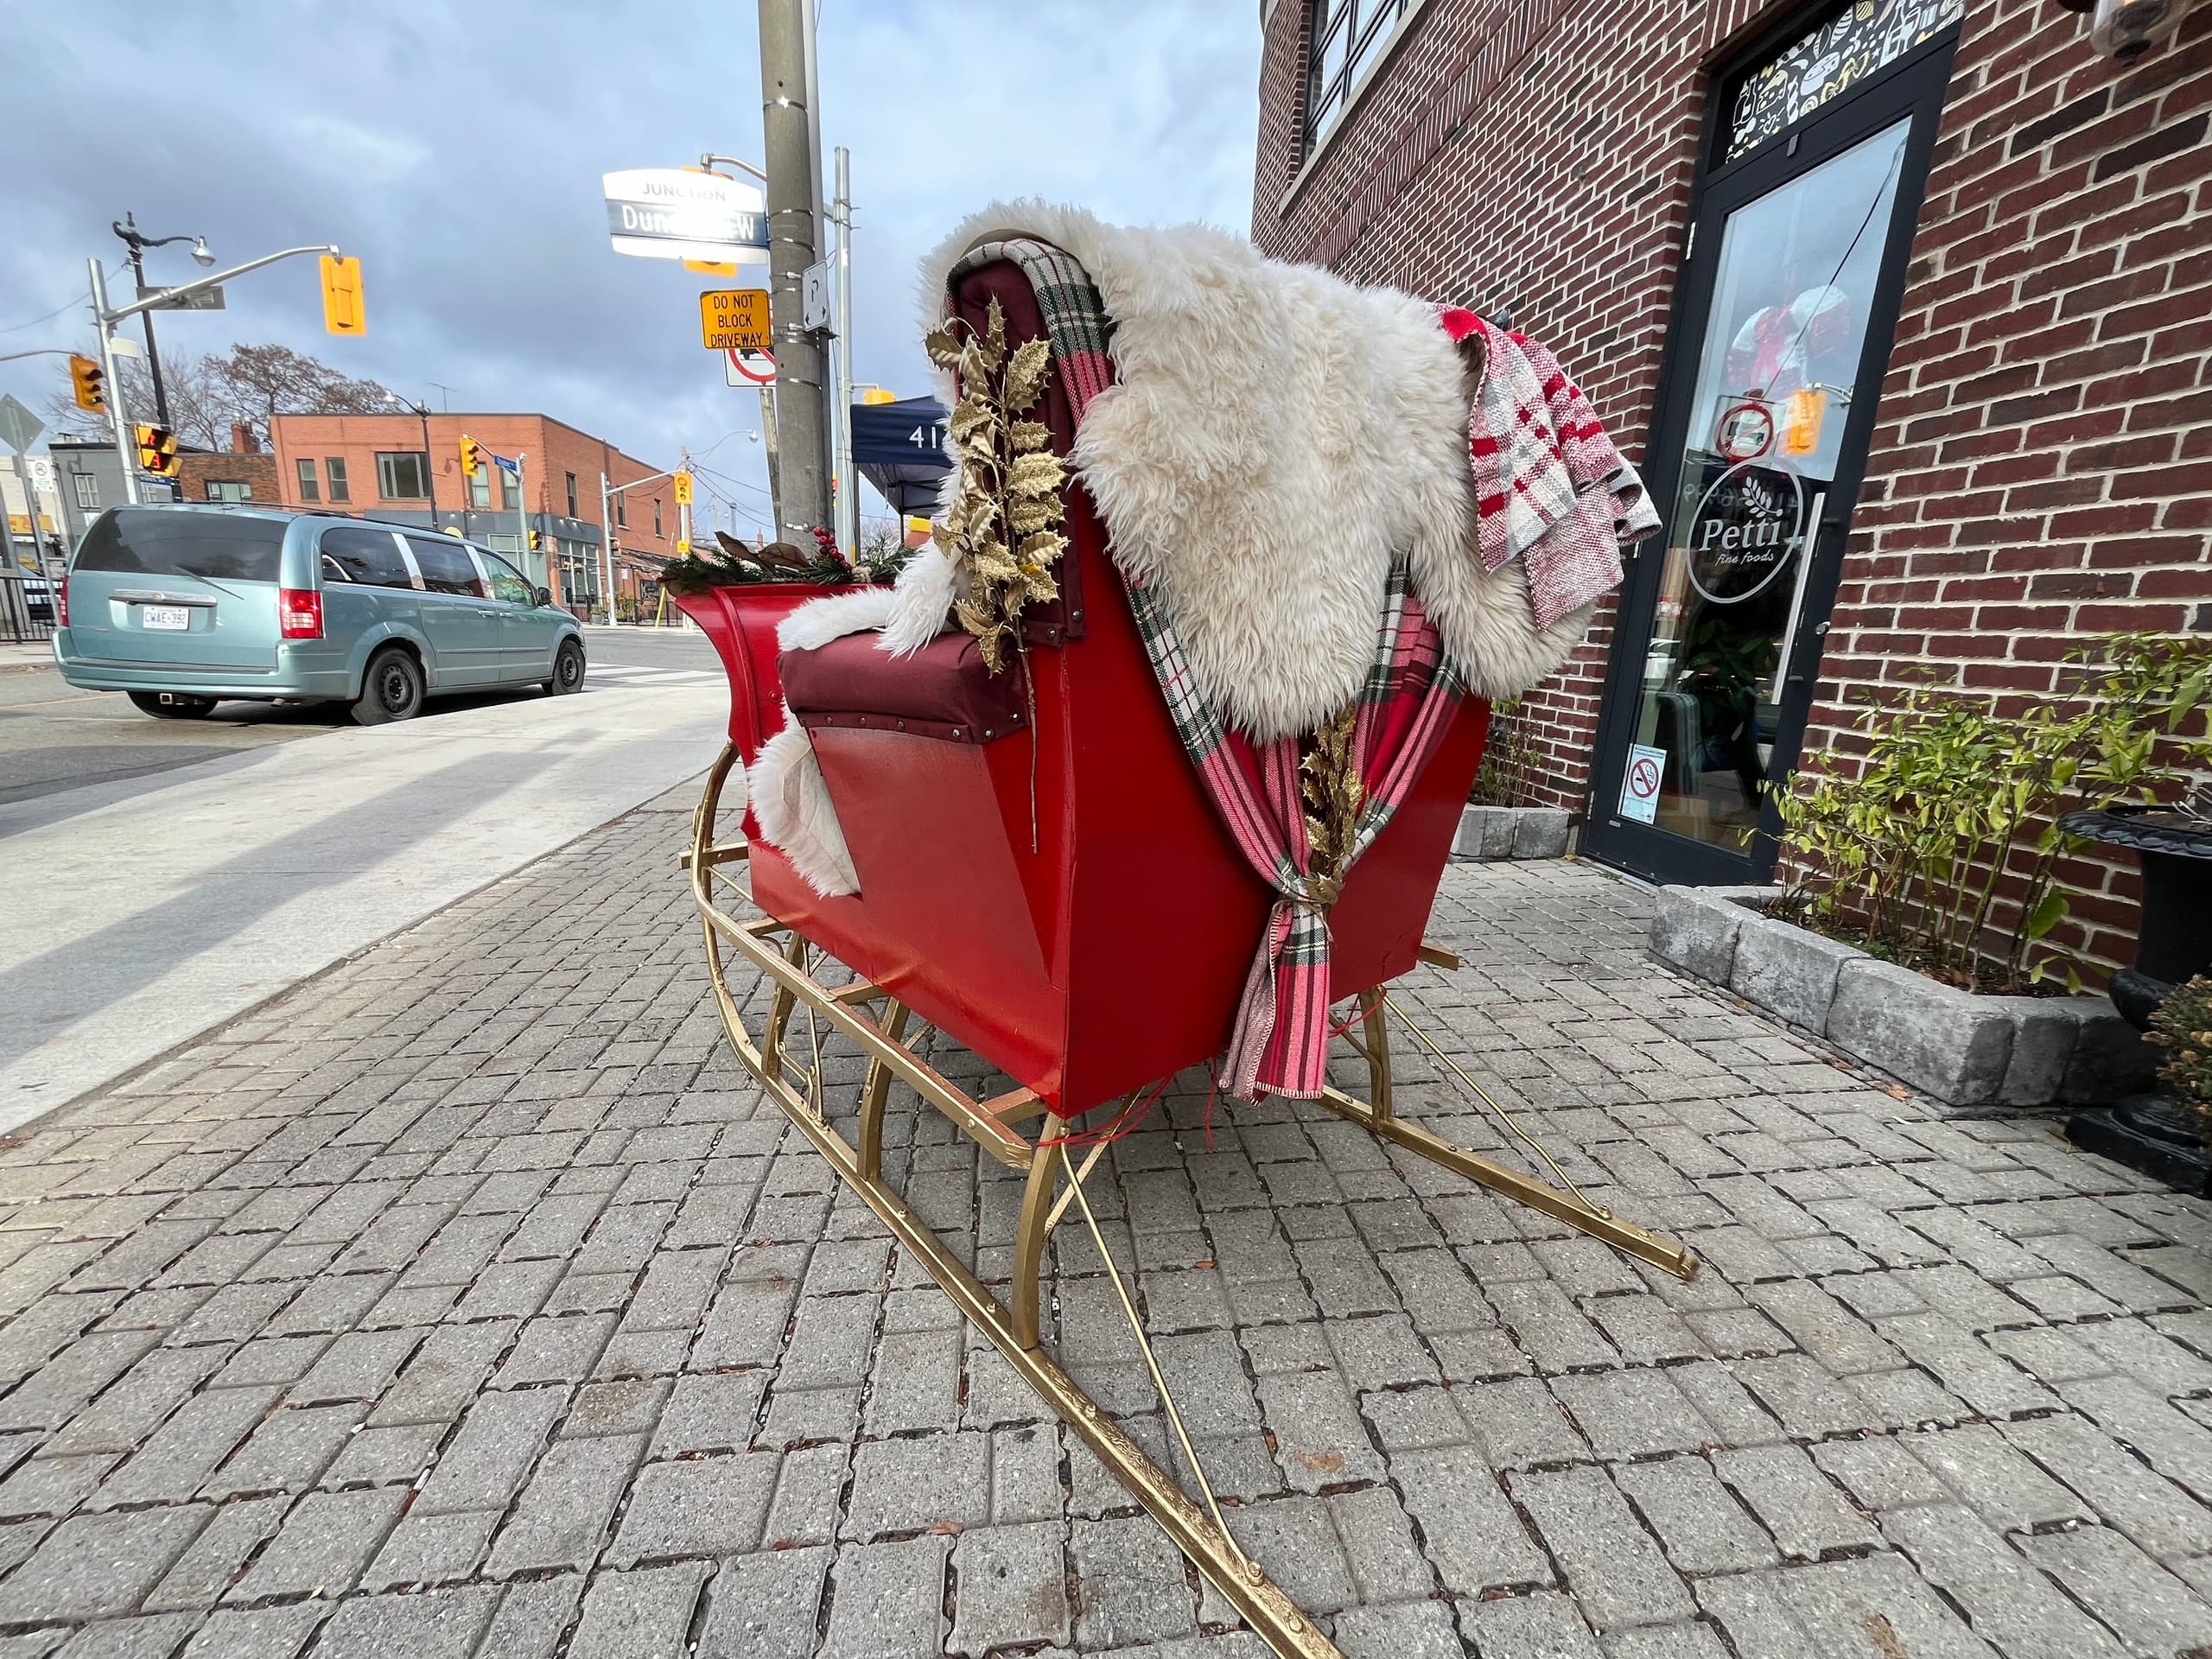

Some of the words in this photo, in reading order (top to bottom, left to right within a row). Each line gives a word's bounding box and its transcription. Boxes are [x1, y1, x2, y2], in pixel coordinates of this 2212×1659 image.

[738, 215, 755, 240] W
[713, 295, 728, 309] DO
[734, 295, 754, 308] NOT
[718, 314, 753, 328] BLOCK
[710, 332, 763, 347] DRIVEWAY
[909, 425, 950, 449] 41
[1699, 518, 1782, 551] Petti
[1714, 554, 1738, 567] fine
[1740, 549, 1775, 565] foods
